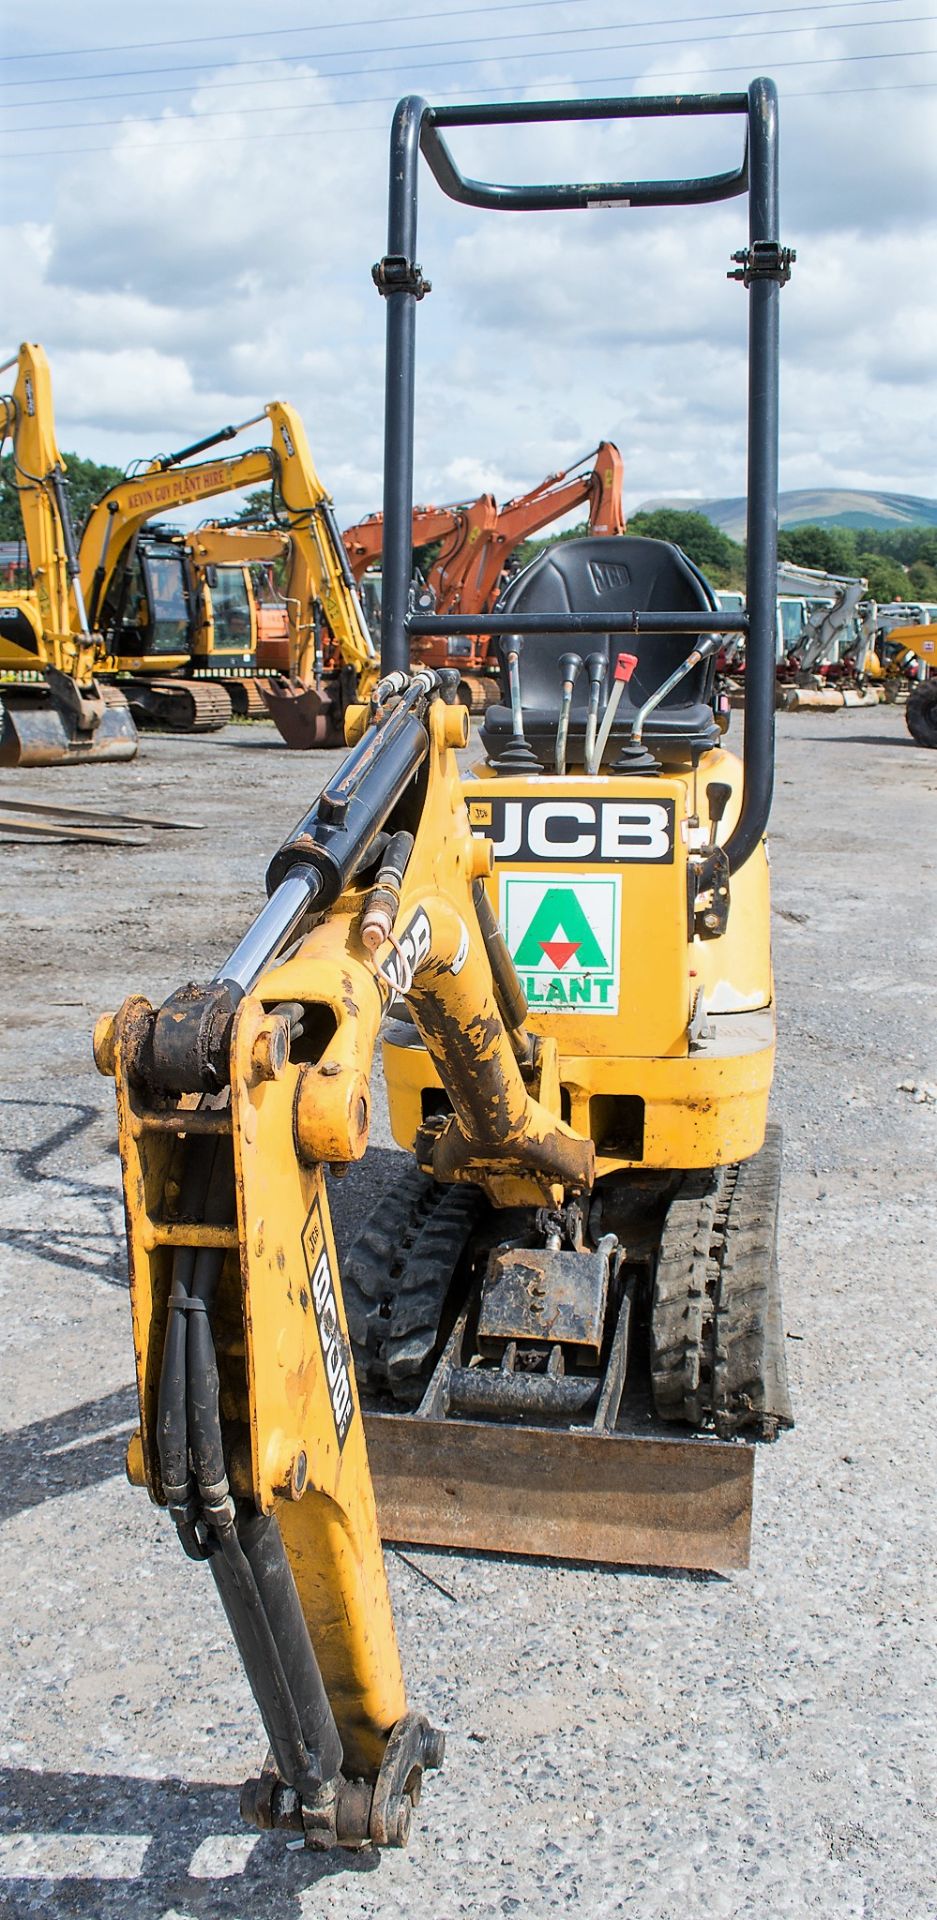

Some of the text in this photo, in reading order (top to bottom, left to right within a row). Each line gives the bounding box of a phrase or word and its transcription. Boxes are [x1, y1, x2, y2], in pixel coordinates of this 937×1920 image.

[127, 469, 226, 509] KEVIN GUY PLANT HIRE
[471, 802, 671, 859] JCB
[512, 888, 609, 968] A
[519, 977, 614, 1003] LANT
